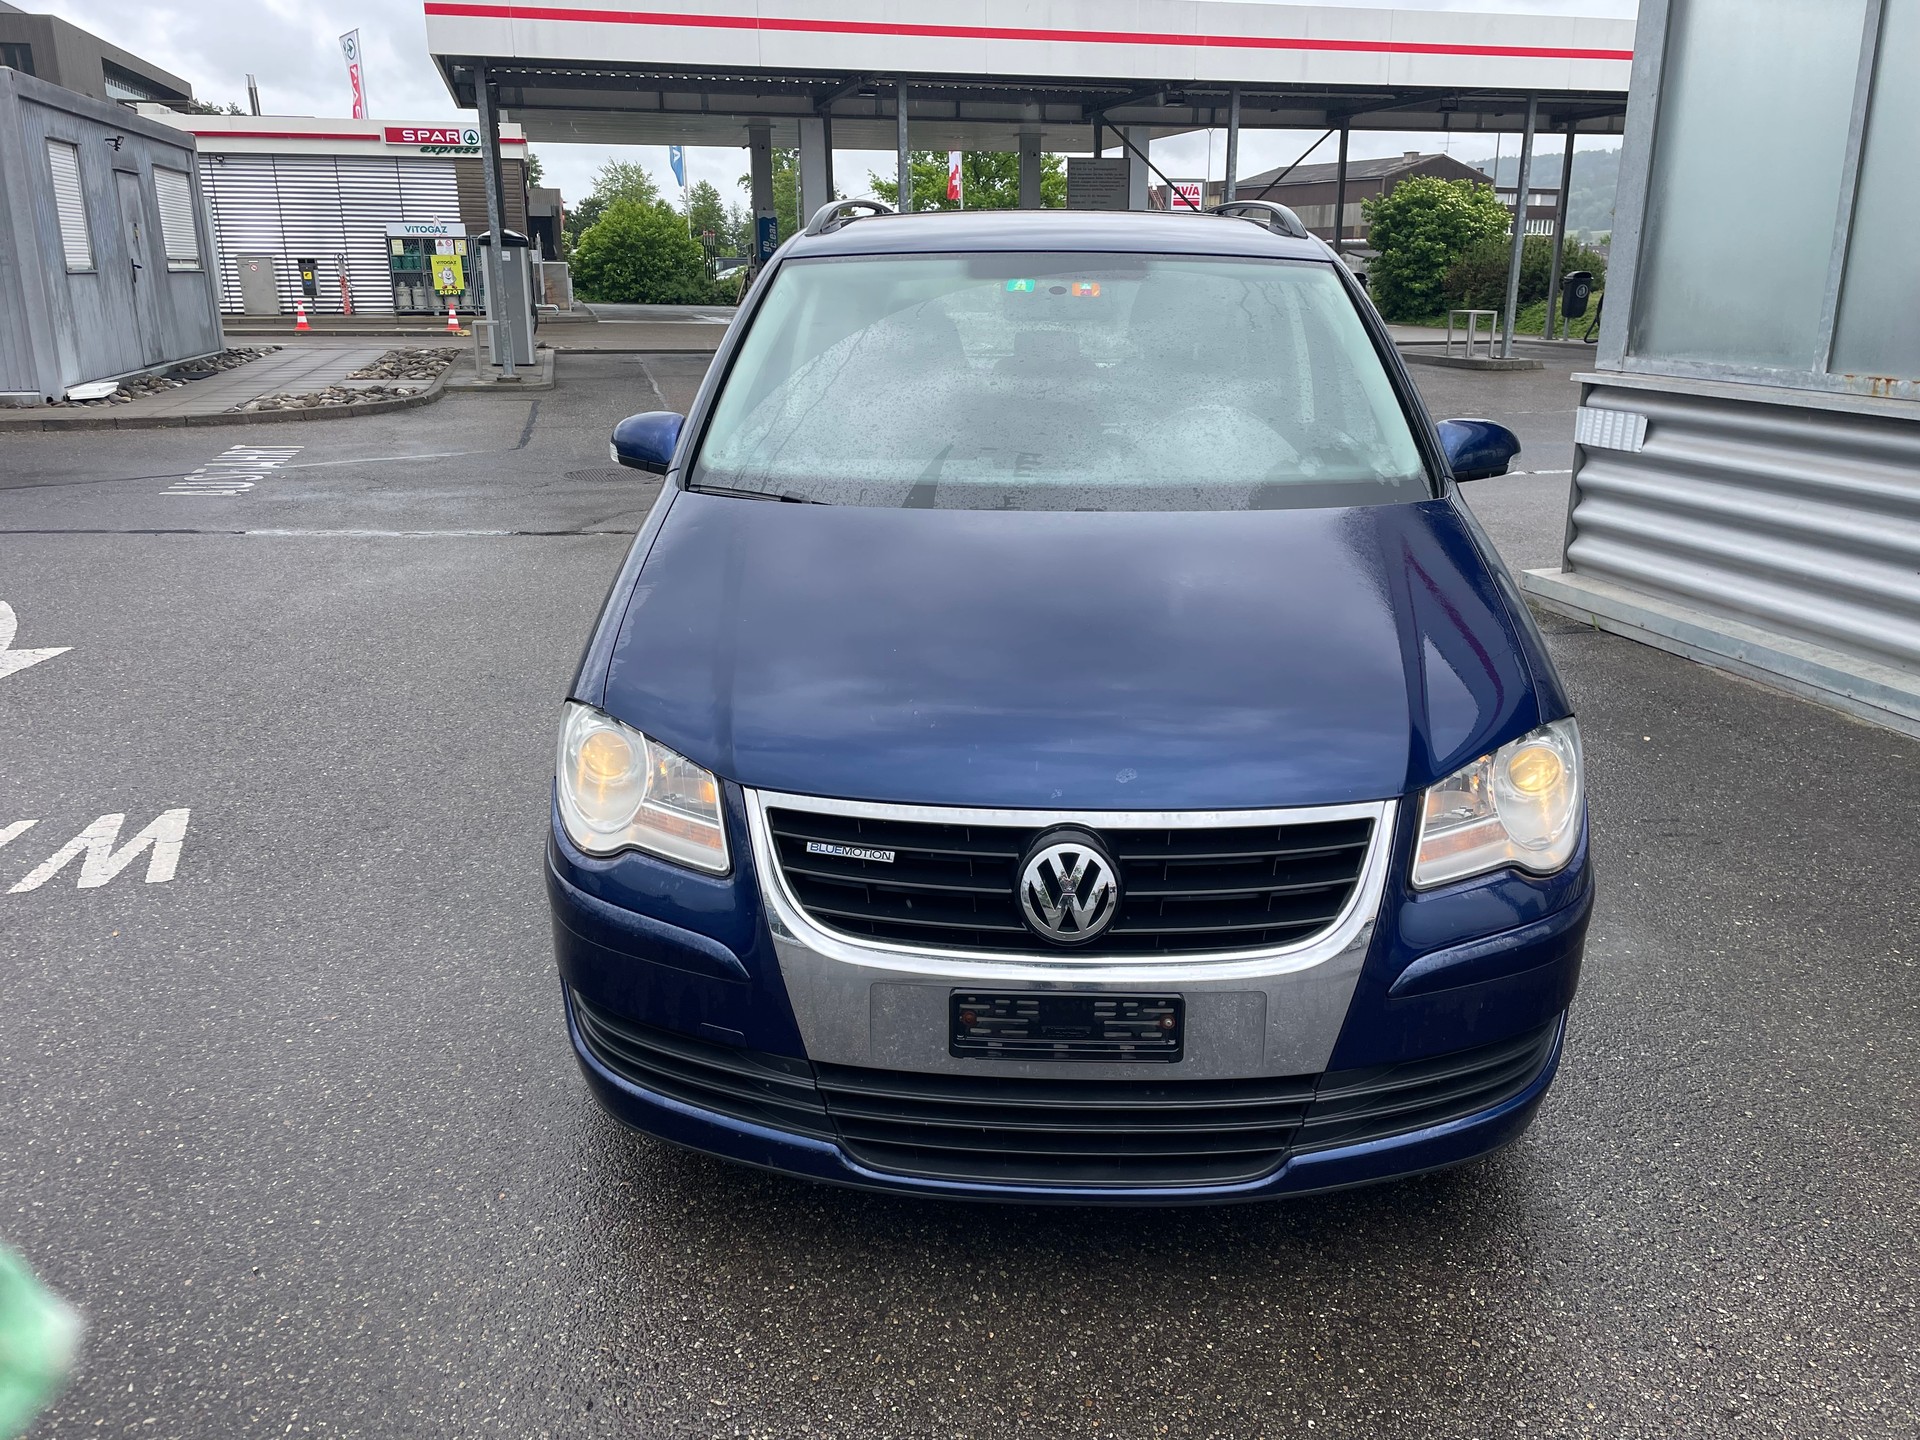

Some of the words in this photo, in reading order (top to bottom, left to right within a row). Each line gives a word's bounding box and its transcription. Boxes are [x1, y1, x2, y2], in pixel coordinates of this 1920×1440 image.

[402, 129, 460, 143] SPAR
[419, 145, 481, 155] express
[762, 240, 772, 253] go
[158, 444, 305, 496] AUSFAHRT
[810, 842, 892, 861] BLUEMOTION
[1020, 843, 1118, 942] VW
